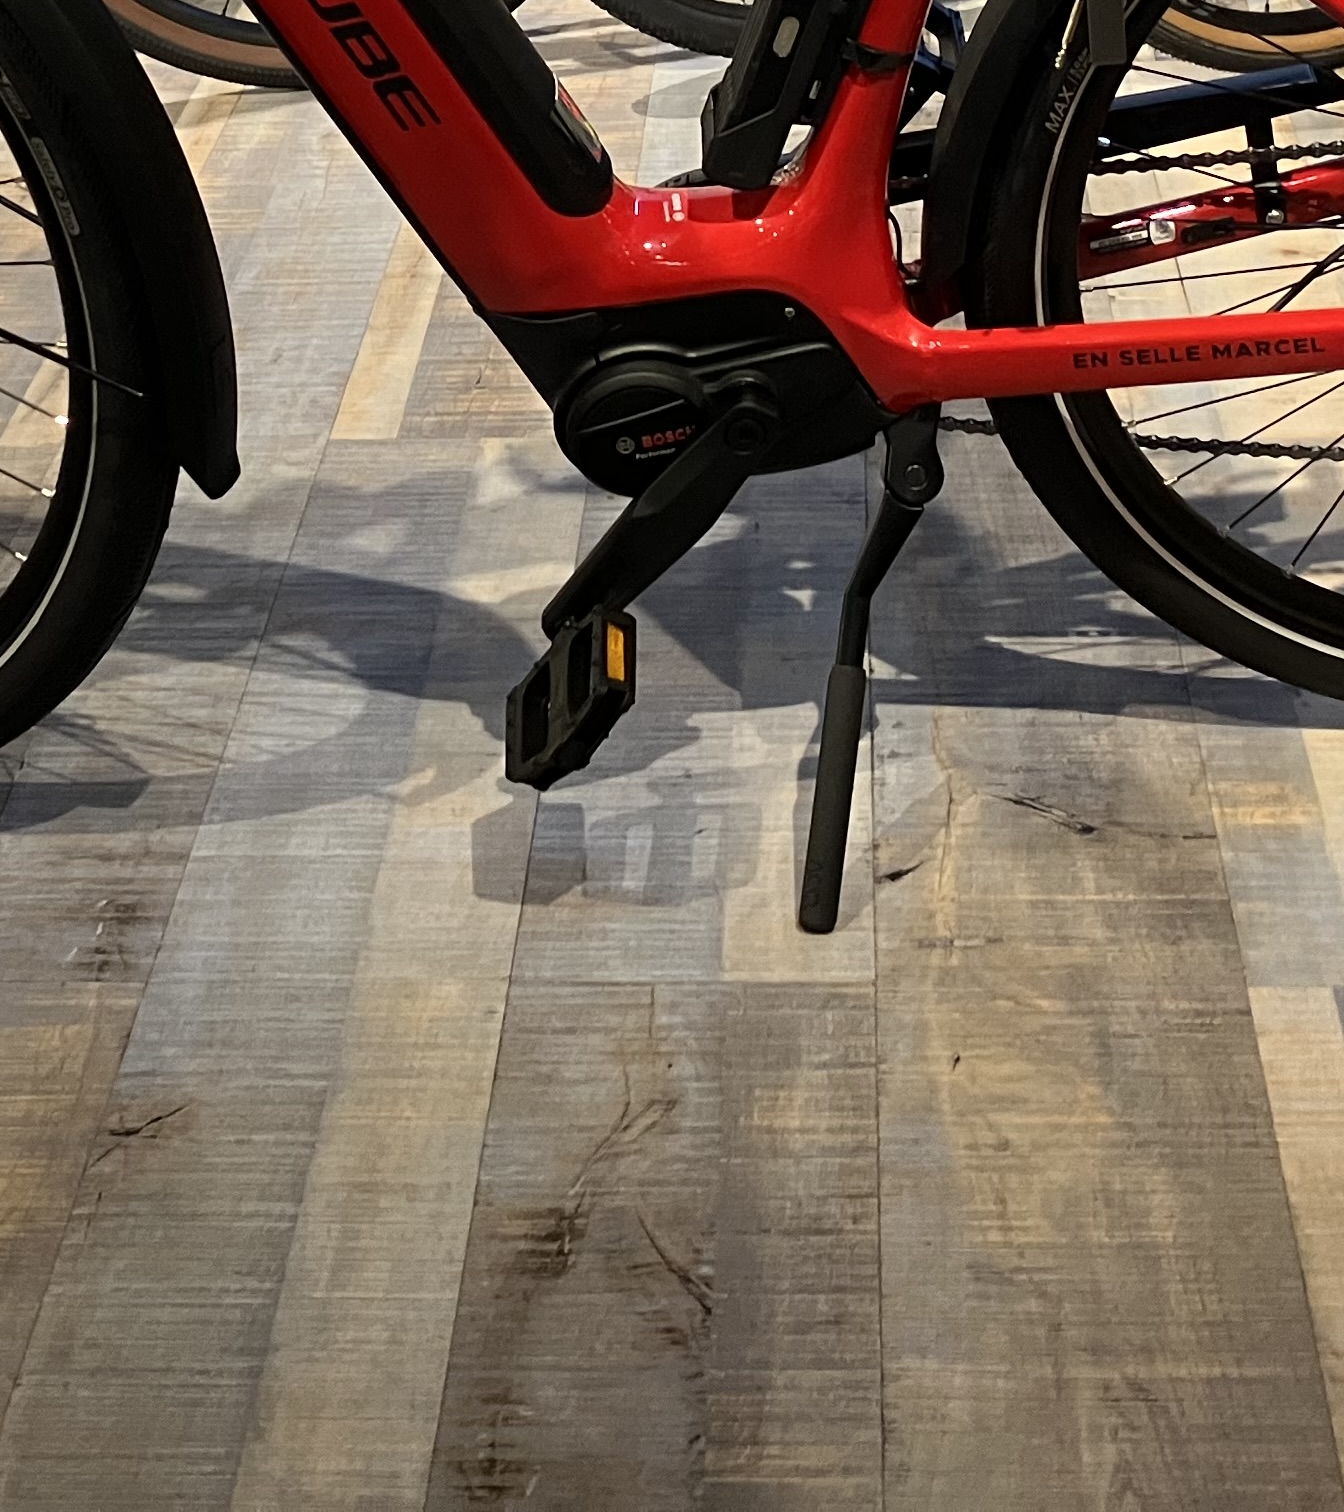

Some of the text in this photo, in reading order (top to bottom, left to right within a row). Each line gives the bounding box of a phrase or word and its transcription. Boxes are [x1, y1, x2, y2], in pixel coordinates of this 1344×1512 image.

[1072, 336, 1326, 369] EN SELLE MARCEL
